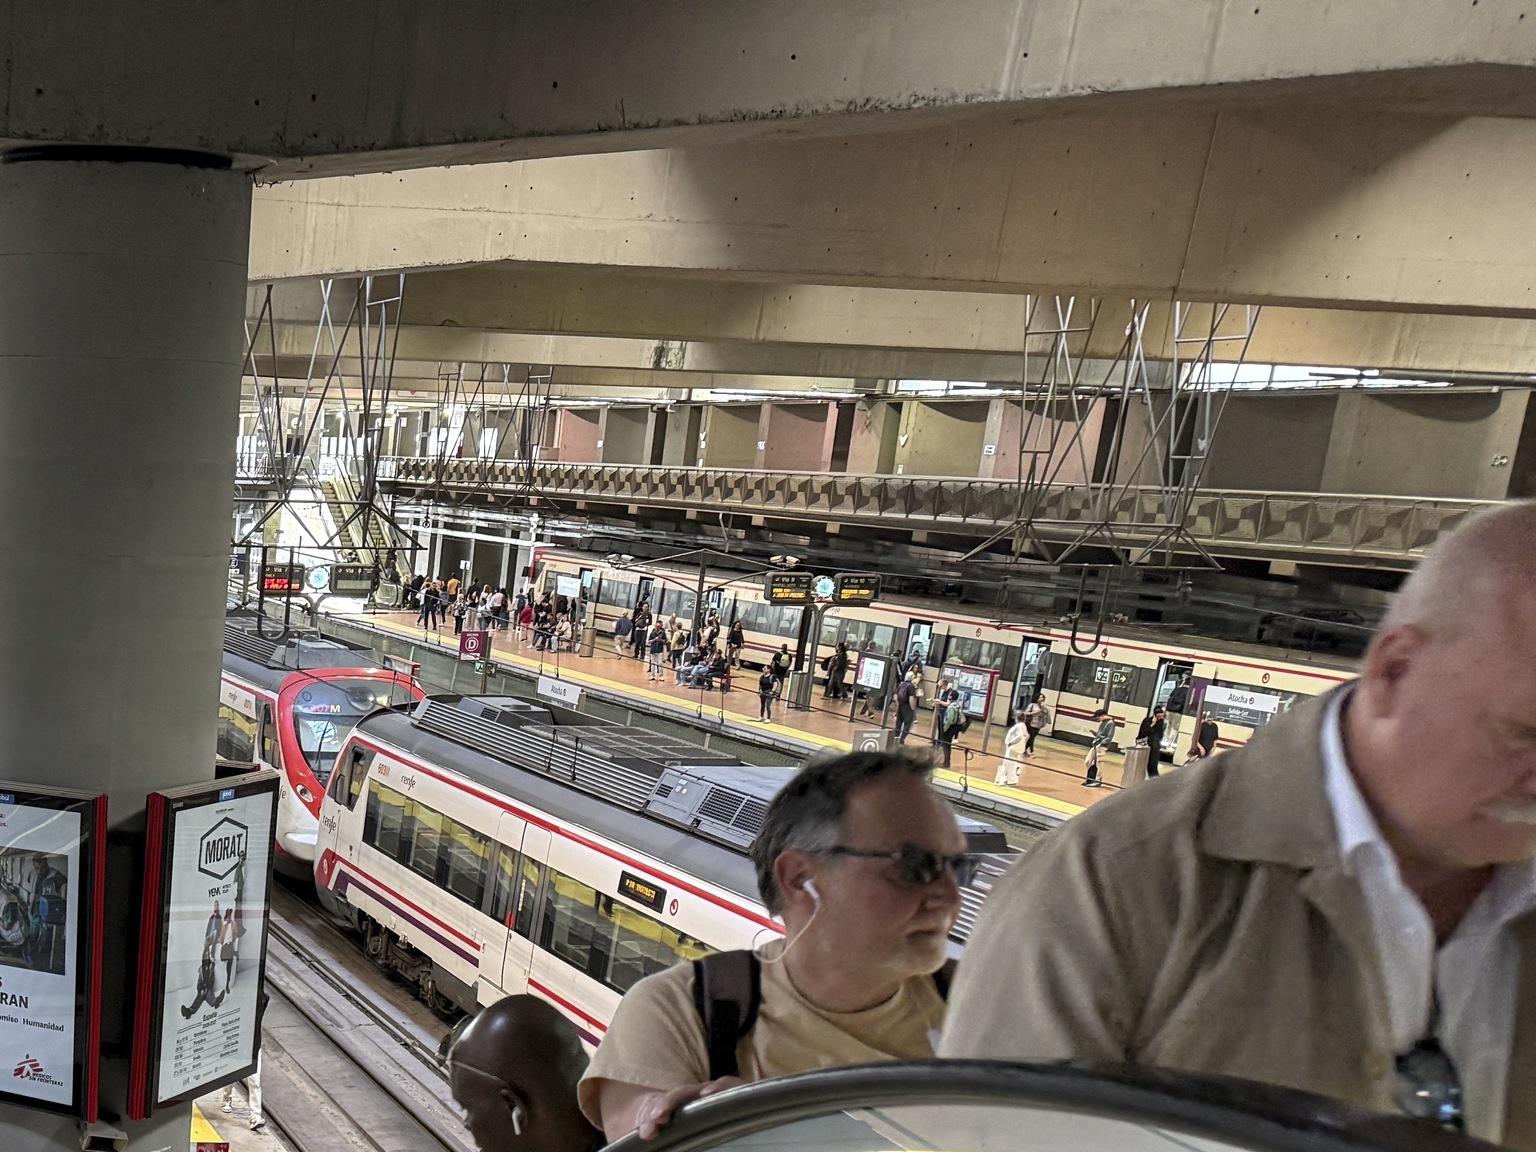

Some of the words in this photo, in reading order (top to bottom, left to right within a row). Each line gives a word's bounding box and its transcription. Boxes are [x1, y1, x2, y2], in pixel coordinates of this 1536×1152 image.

[550, 684, 562, 695] Atocha
[1228, 693, 1248, 704] Atocha
[401, 775, 416, 791] renfe
[323, 815, 336, 834] renfe
[205, 833, 243, 864] MORAT
[23, 1018, 64, 1032] Humanidad
